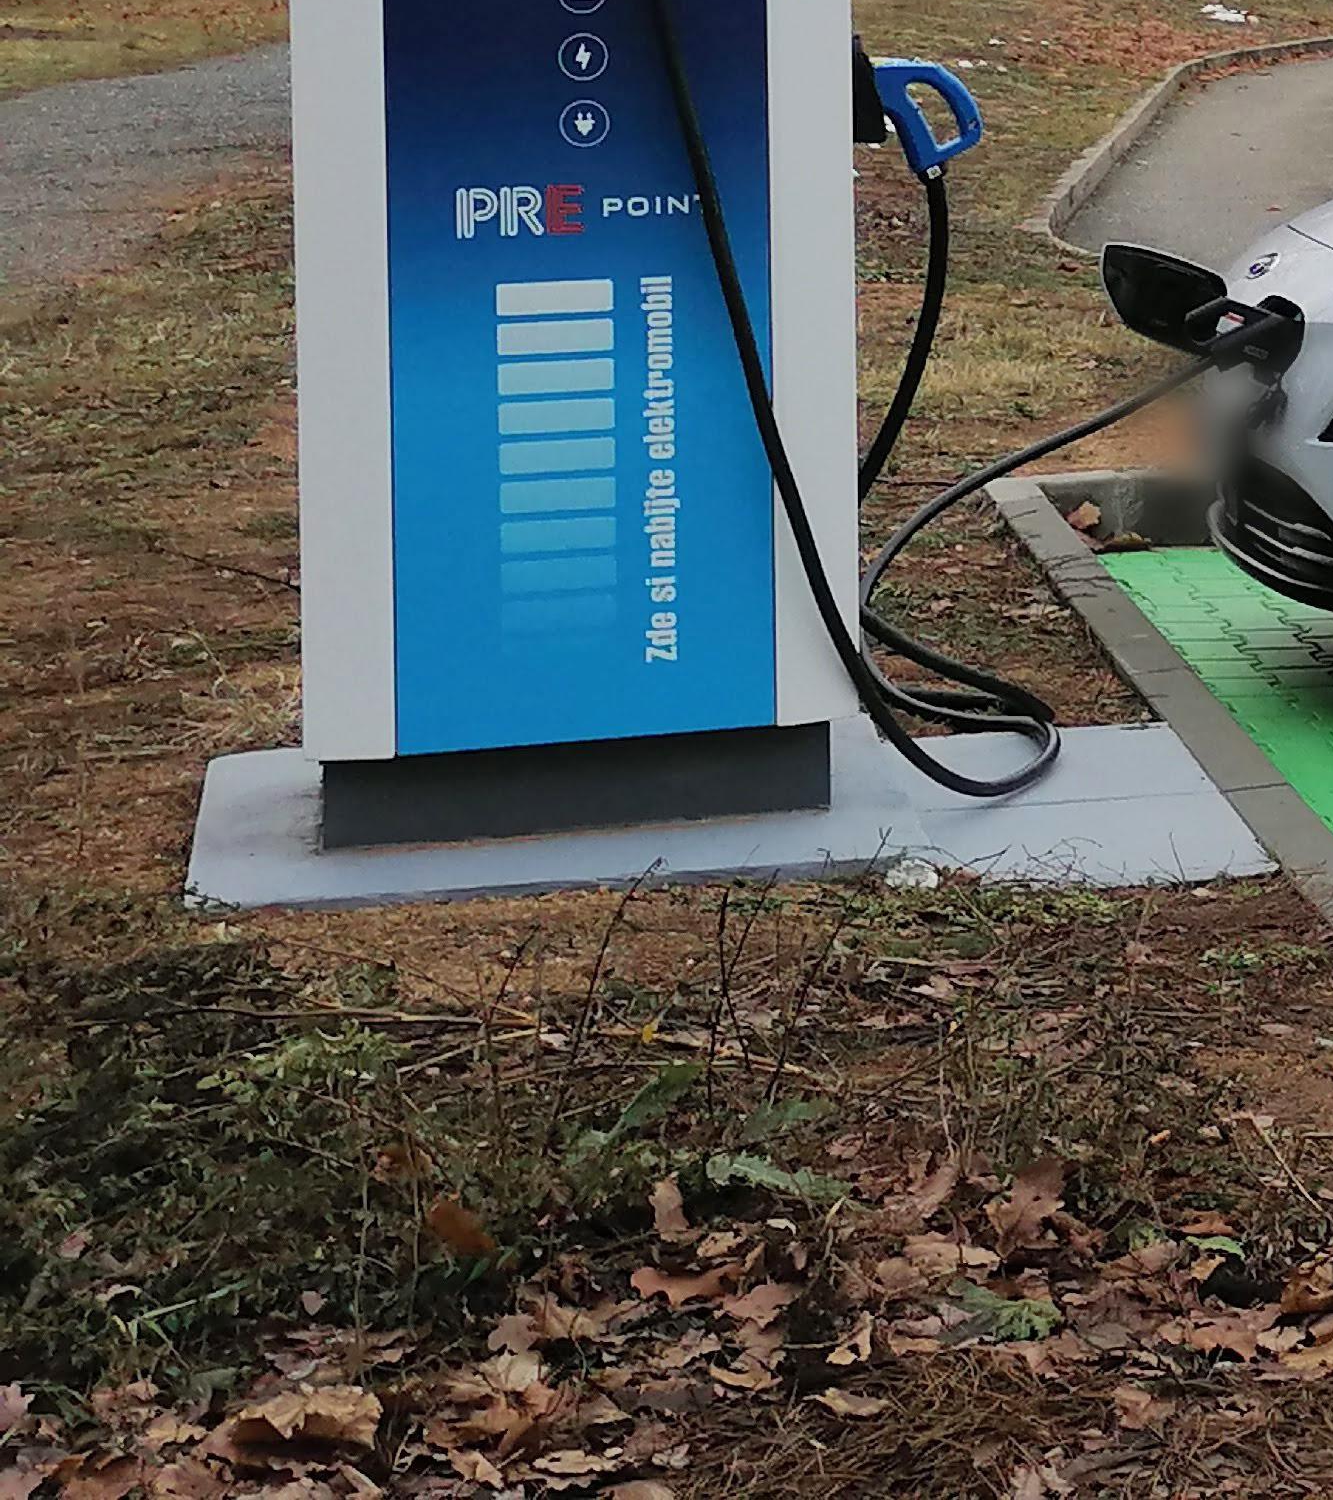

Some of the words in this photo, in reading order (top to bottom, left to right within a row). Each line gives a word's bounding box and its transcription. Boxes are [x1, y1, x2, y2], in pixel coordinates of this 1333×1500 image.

[455, 185, 586, 240] PRE
[602, 194, 700, 218] POIN
[640, 276, 676, 460] elektromobil
[643, 469, 681, 567] nabijte
[645, 575, 677, 604] si
[645, 612, 678, 664] Zde
